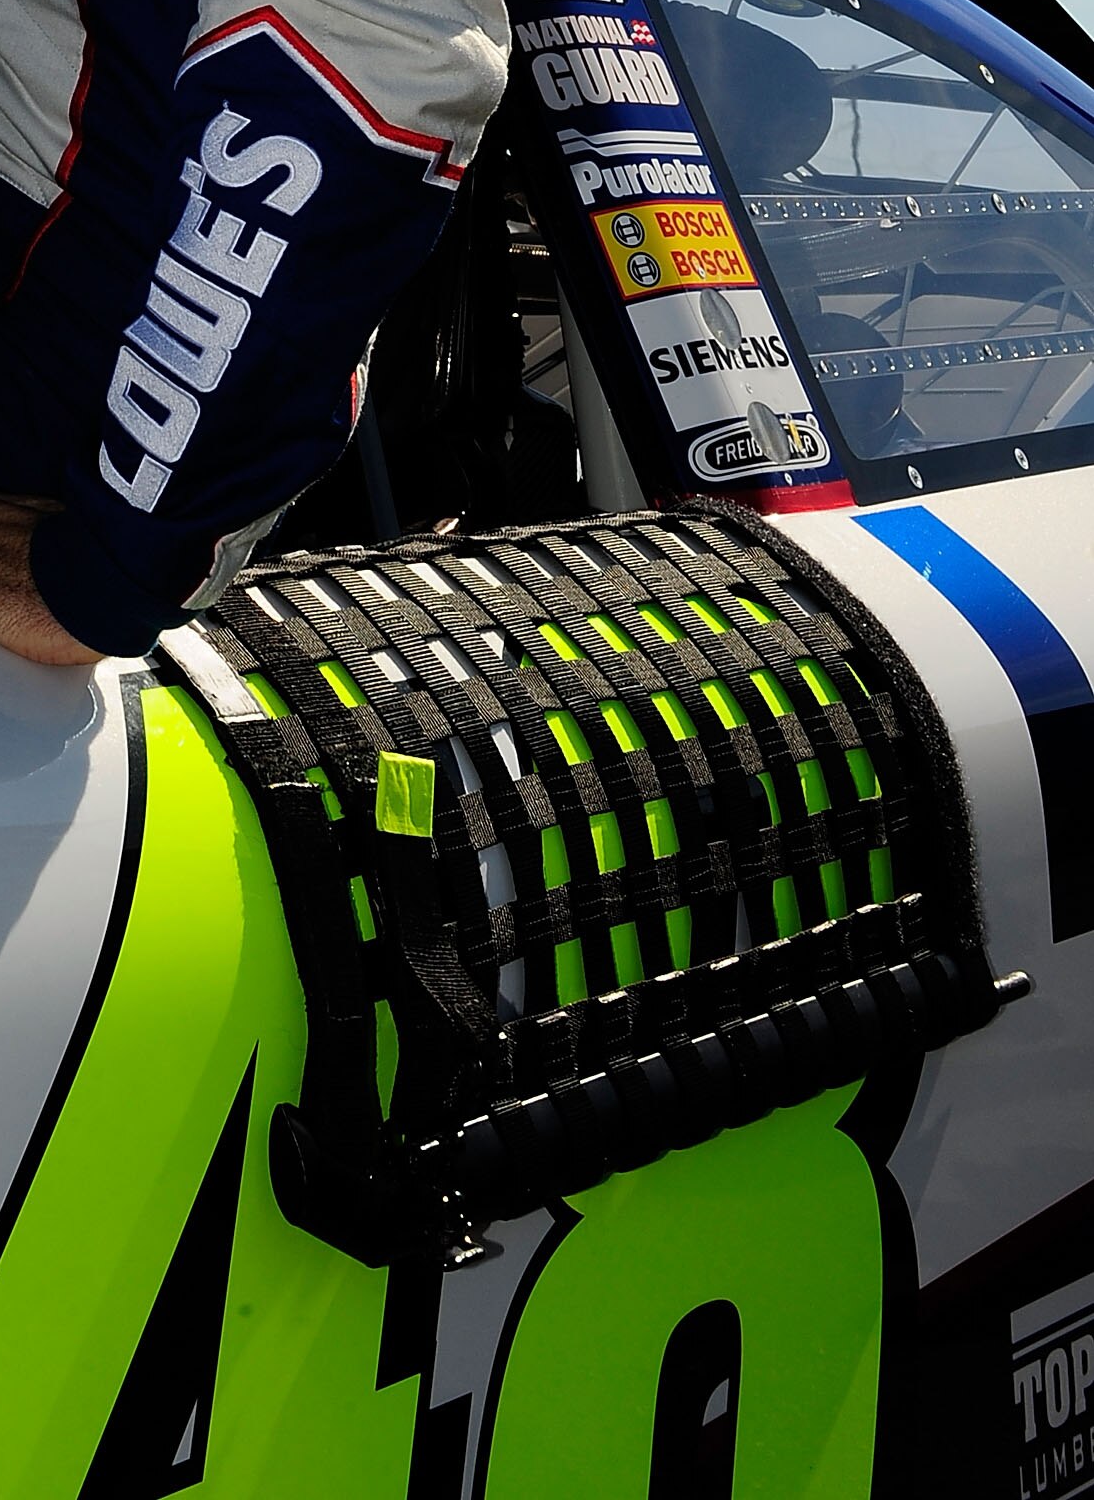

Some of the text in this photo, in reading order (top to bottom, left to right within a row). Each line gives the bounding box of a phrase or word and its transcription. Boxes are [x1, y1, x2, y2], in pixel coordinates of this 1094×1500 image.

[514, 14, 634, 52] NATIONAL
[531, 47, 680, 111] GUARD
[569, 158, 717, 206] Purolator
[654, 211, 729, 238] BOSCH
[670, 250, 745, 277] BOSCH
[98, 107, 323, 514] LOWE'S
